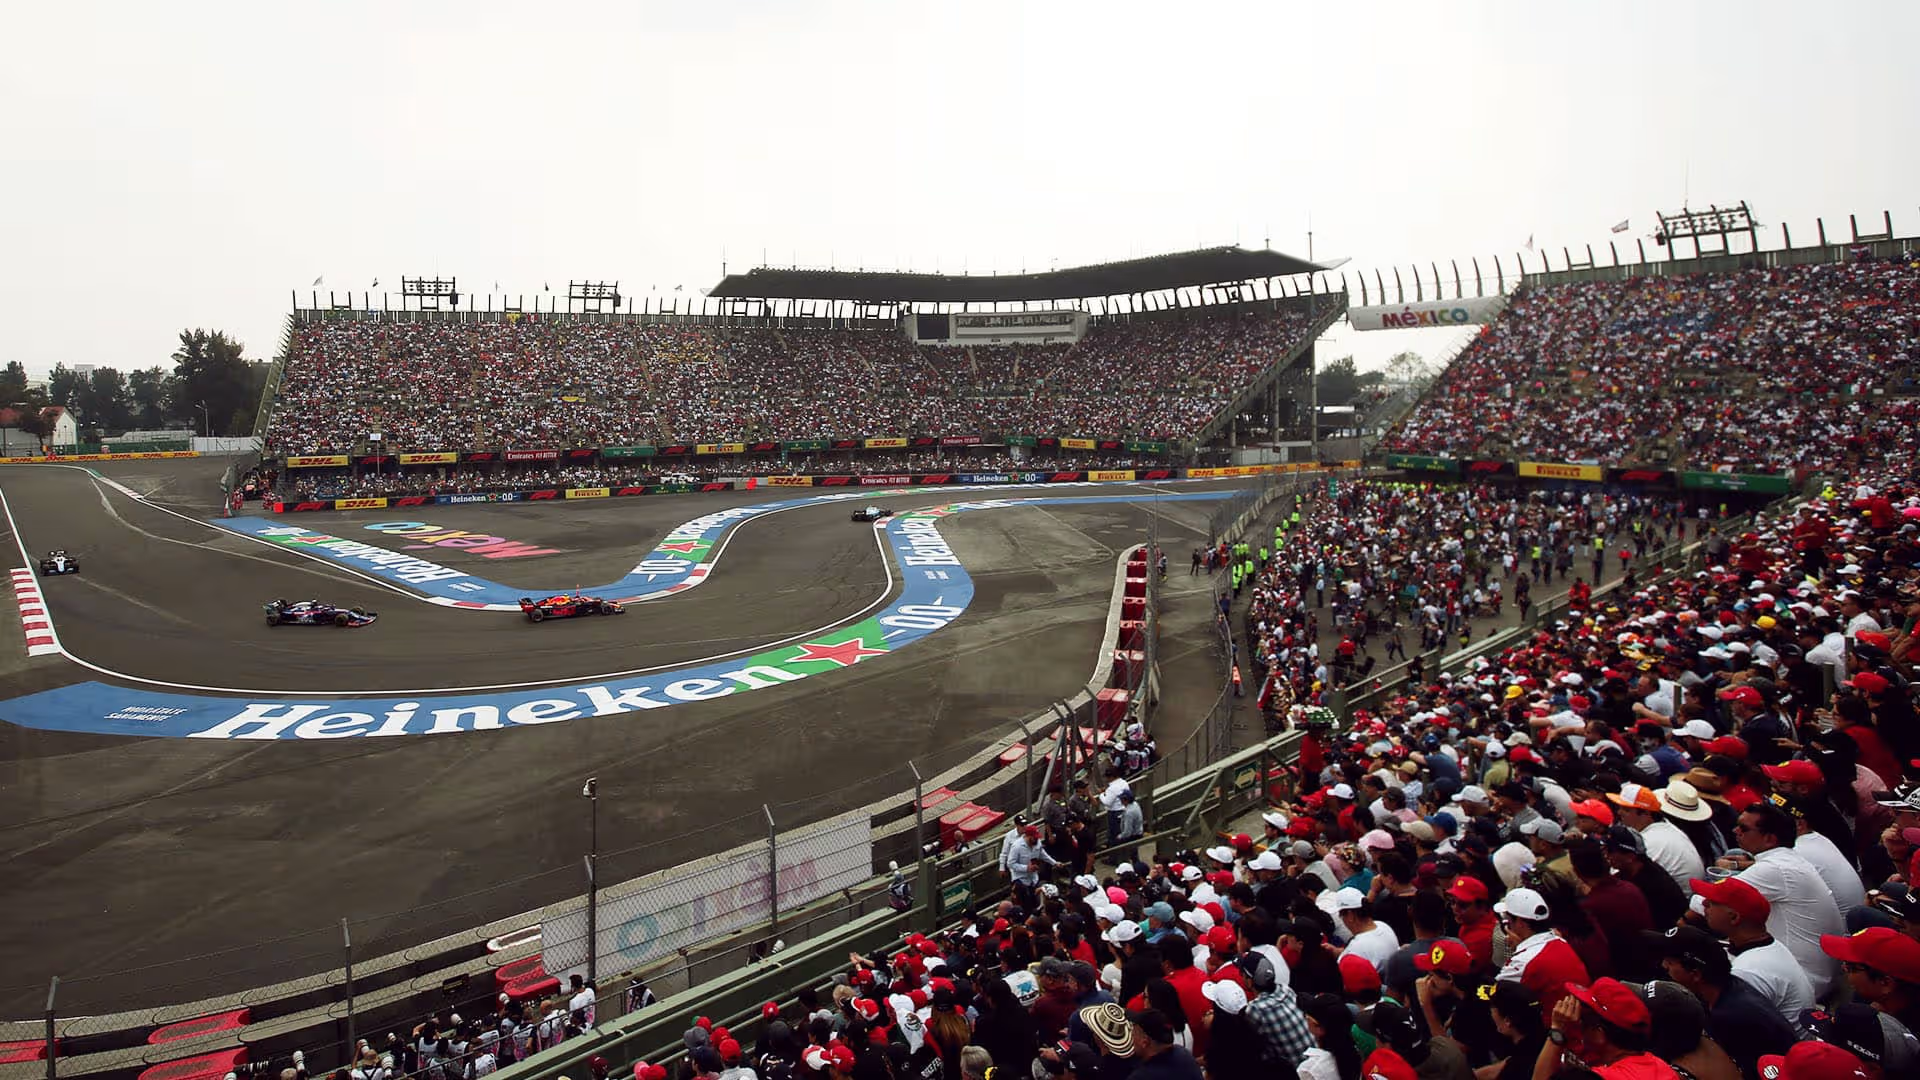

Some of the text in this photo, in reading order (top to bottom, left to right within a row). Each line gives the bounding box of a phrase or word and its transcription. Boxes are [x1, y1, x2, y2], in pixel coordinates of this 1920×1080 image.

[410, 455, 446, 464] DHL
[507, 452, 534, 460] Emirates
[299, 457, 335, 466] DHL
[1097, 472, 1126, 480] PIRELLI
[1536, 466, 1581, 478] PIRELLI
[773, 478, 806, 486] DHL
[861, 477, 888, 485] Emirates
[973, 474, 1008, 483] Heineken
[574, 490, 602, 498] PIRELLI
[344, 498, 379, 508] DHL
[450, 495, 487, 503] Heineken
[894, 517, 961, 566] Heineken
[316, 539, 470, 584] Heineken
[184, 662, 808, 740] Heineken
